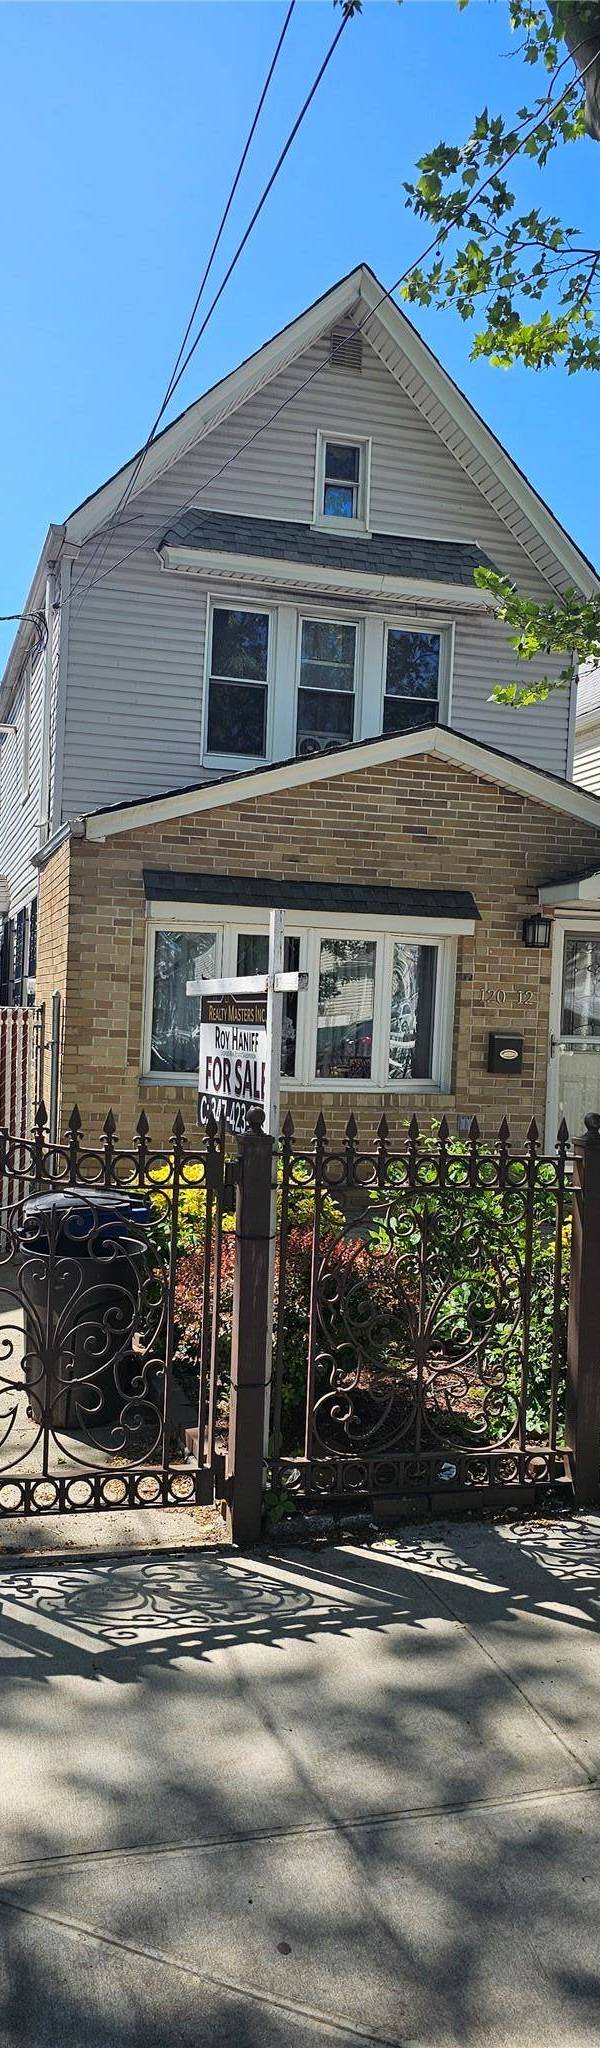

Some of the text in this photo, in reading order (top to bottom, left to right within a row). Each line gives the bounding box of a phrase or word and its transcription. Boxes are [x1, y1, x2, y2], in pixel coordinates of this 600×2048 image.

[480, 988, 536, 1005] 120 12
[208, 1005, 227, 1021] REALTY
[228, 1005, 254, 1021] MASTERS
[215, 1026, 259, 1052] ROY HANIFF
[205, 1056, 231, 1093] FOR
